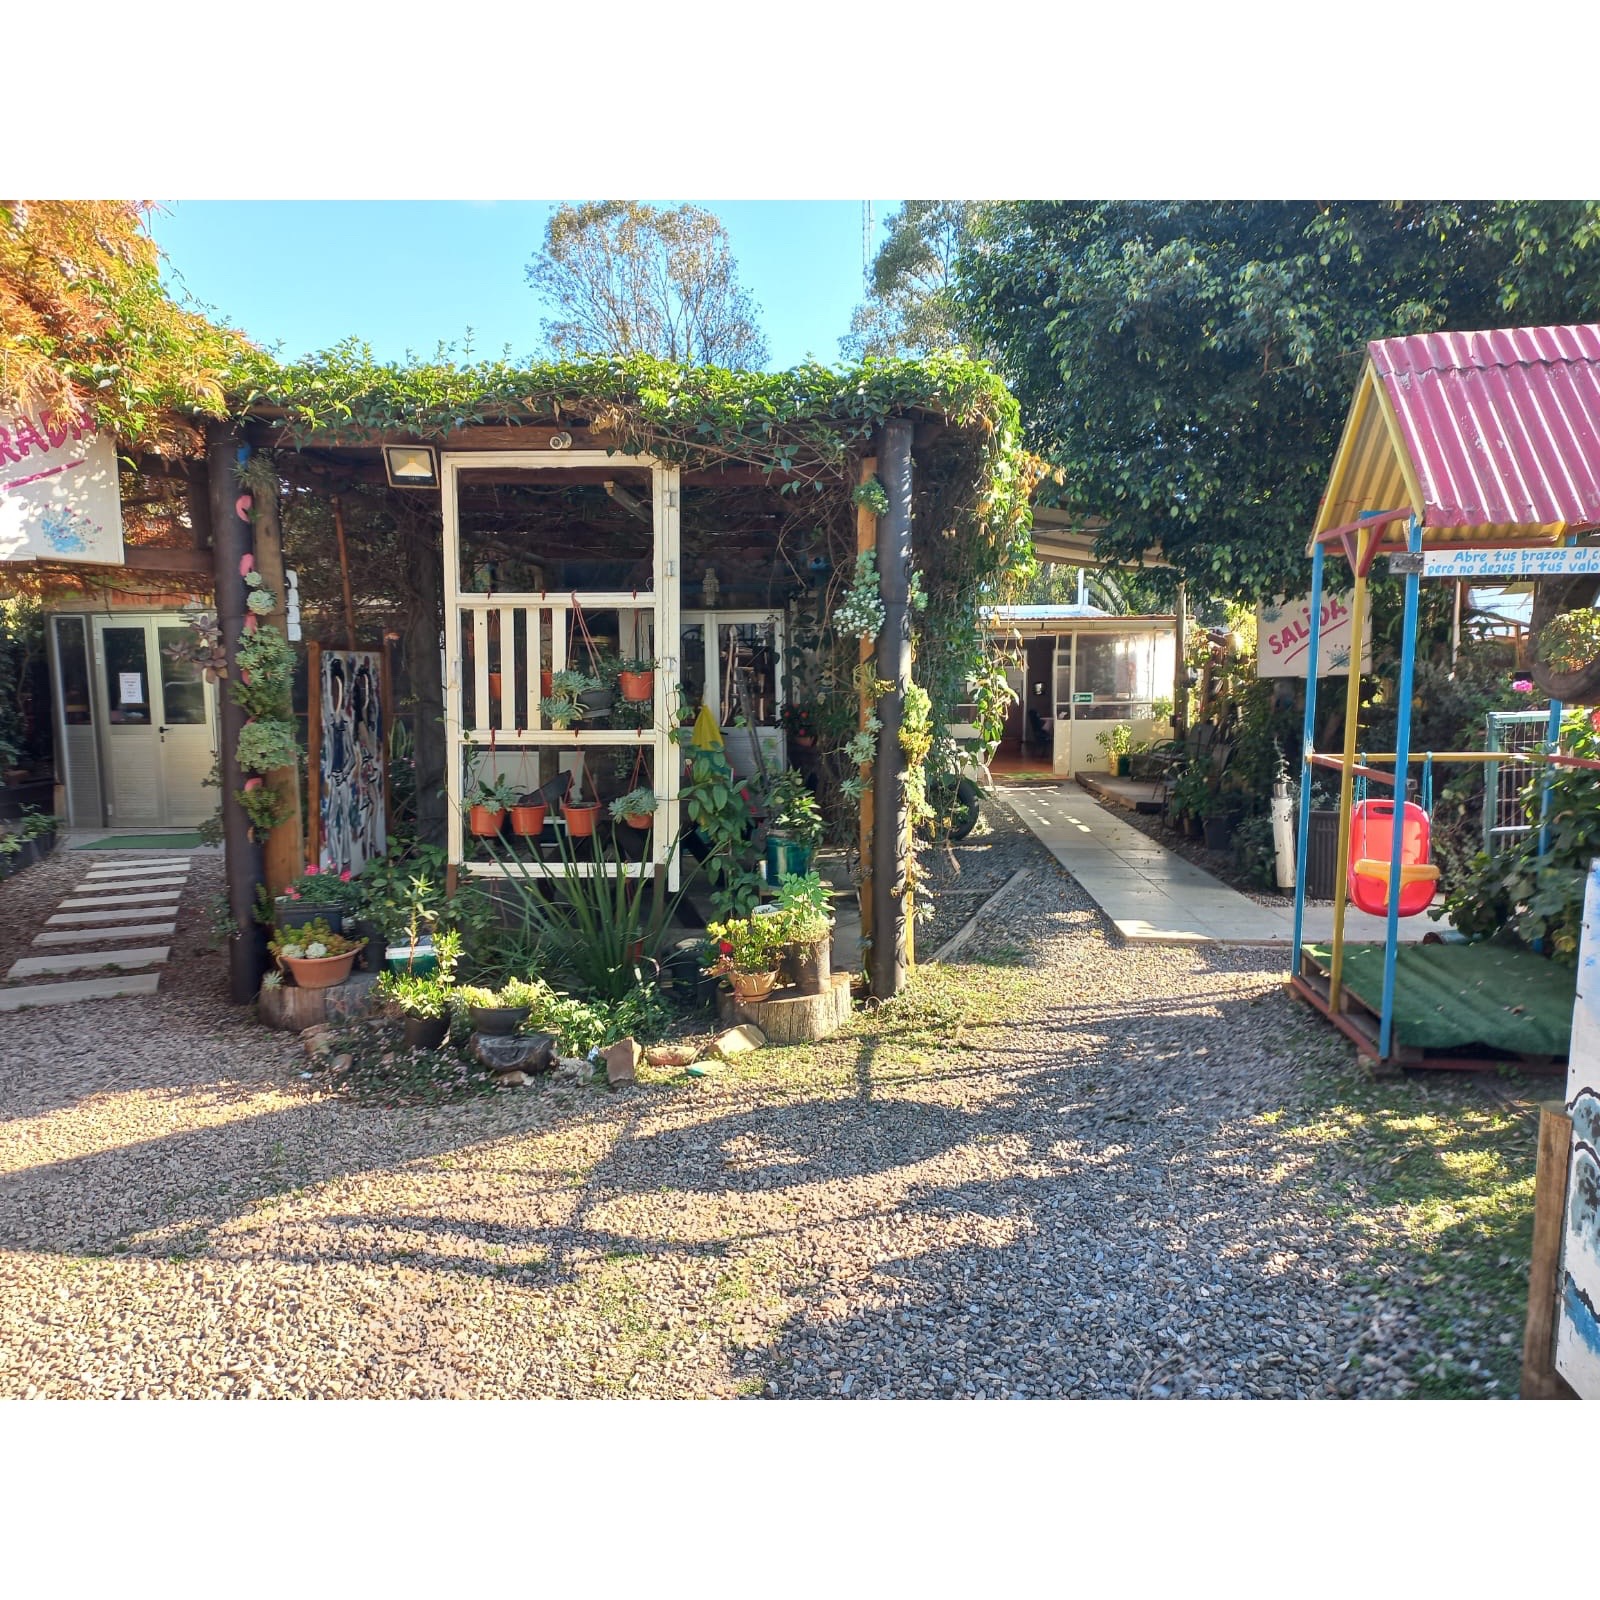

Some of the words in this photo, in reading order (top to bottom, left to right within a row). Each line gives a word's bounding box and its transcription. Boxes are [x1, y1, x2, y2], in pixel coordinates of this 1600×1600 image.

[1453, 551, 1488, 563] Abre
[1494, 550, 1518, 561] tus
[1521, 549, 1567, 561] brazos
[1574, 548, 1588, 559] al
[1592, 550, 1600, 560] c
[1427, 563, 1454, 575] pero
[1460, 564, 1474, 573] no
[1479, 562, 1515, 575] dejes
[1521, 560, 1533, 573] ir
[1537, 560, 1564, 572] tus
[1568, 559, 1600, 571] valo
